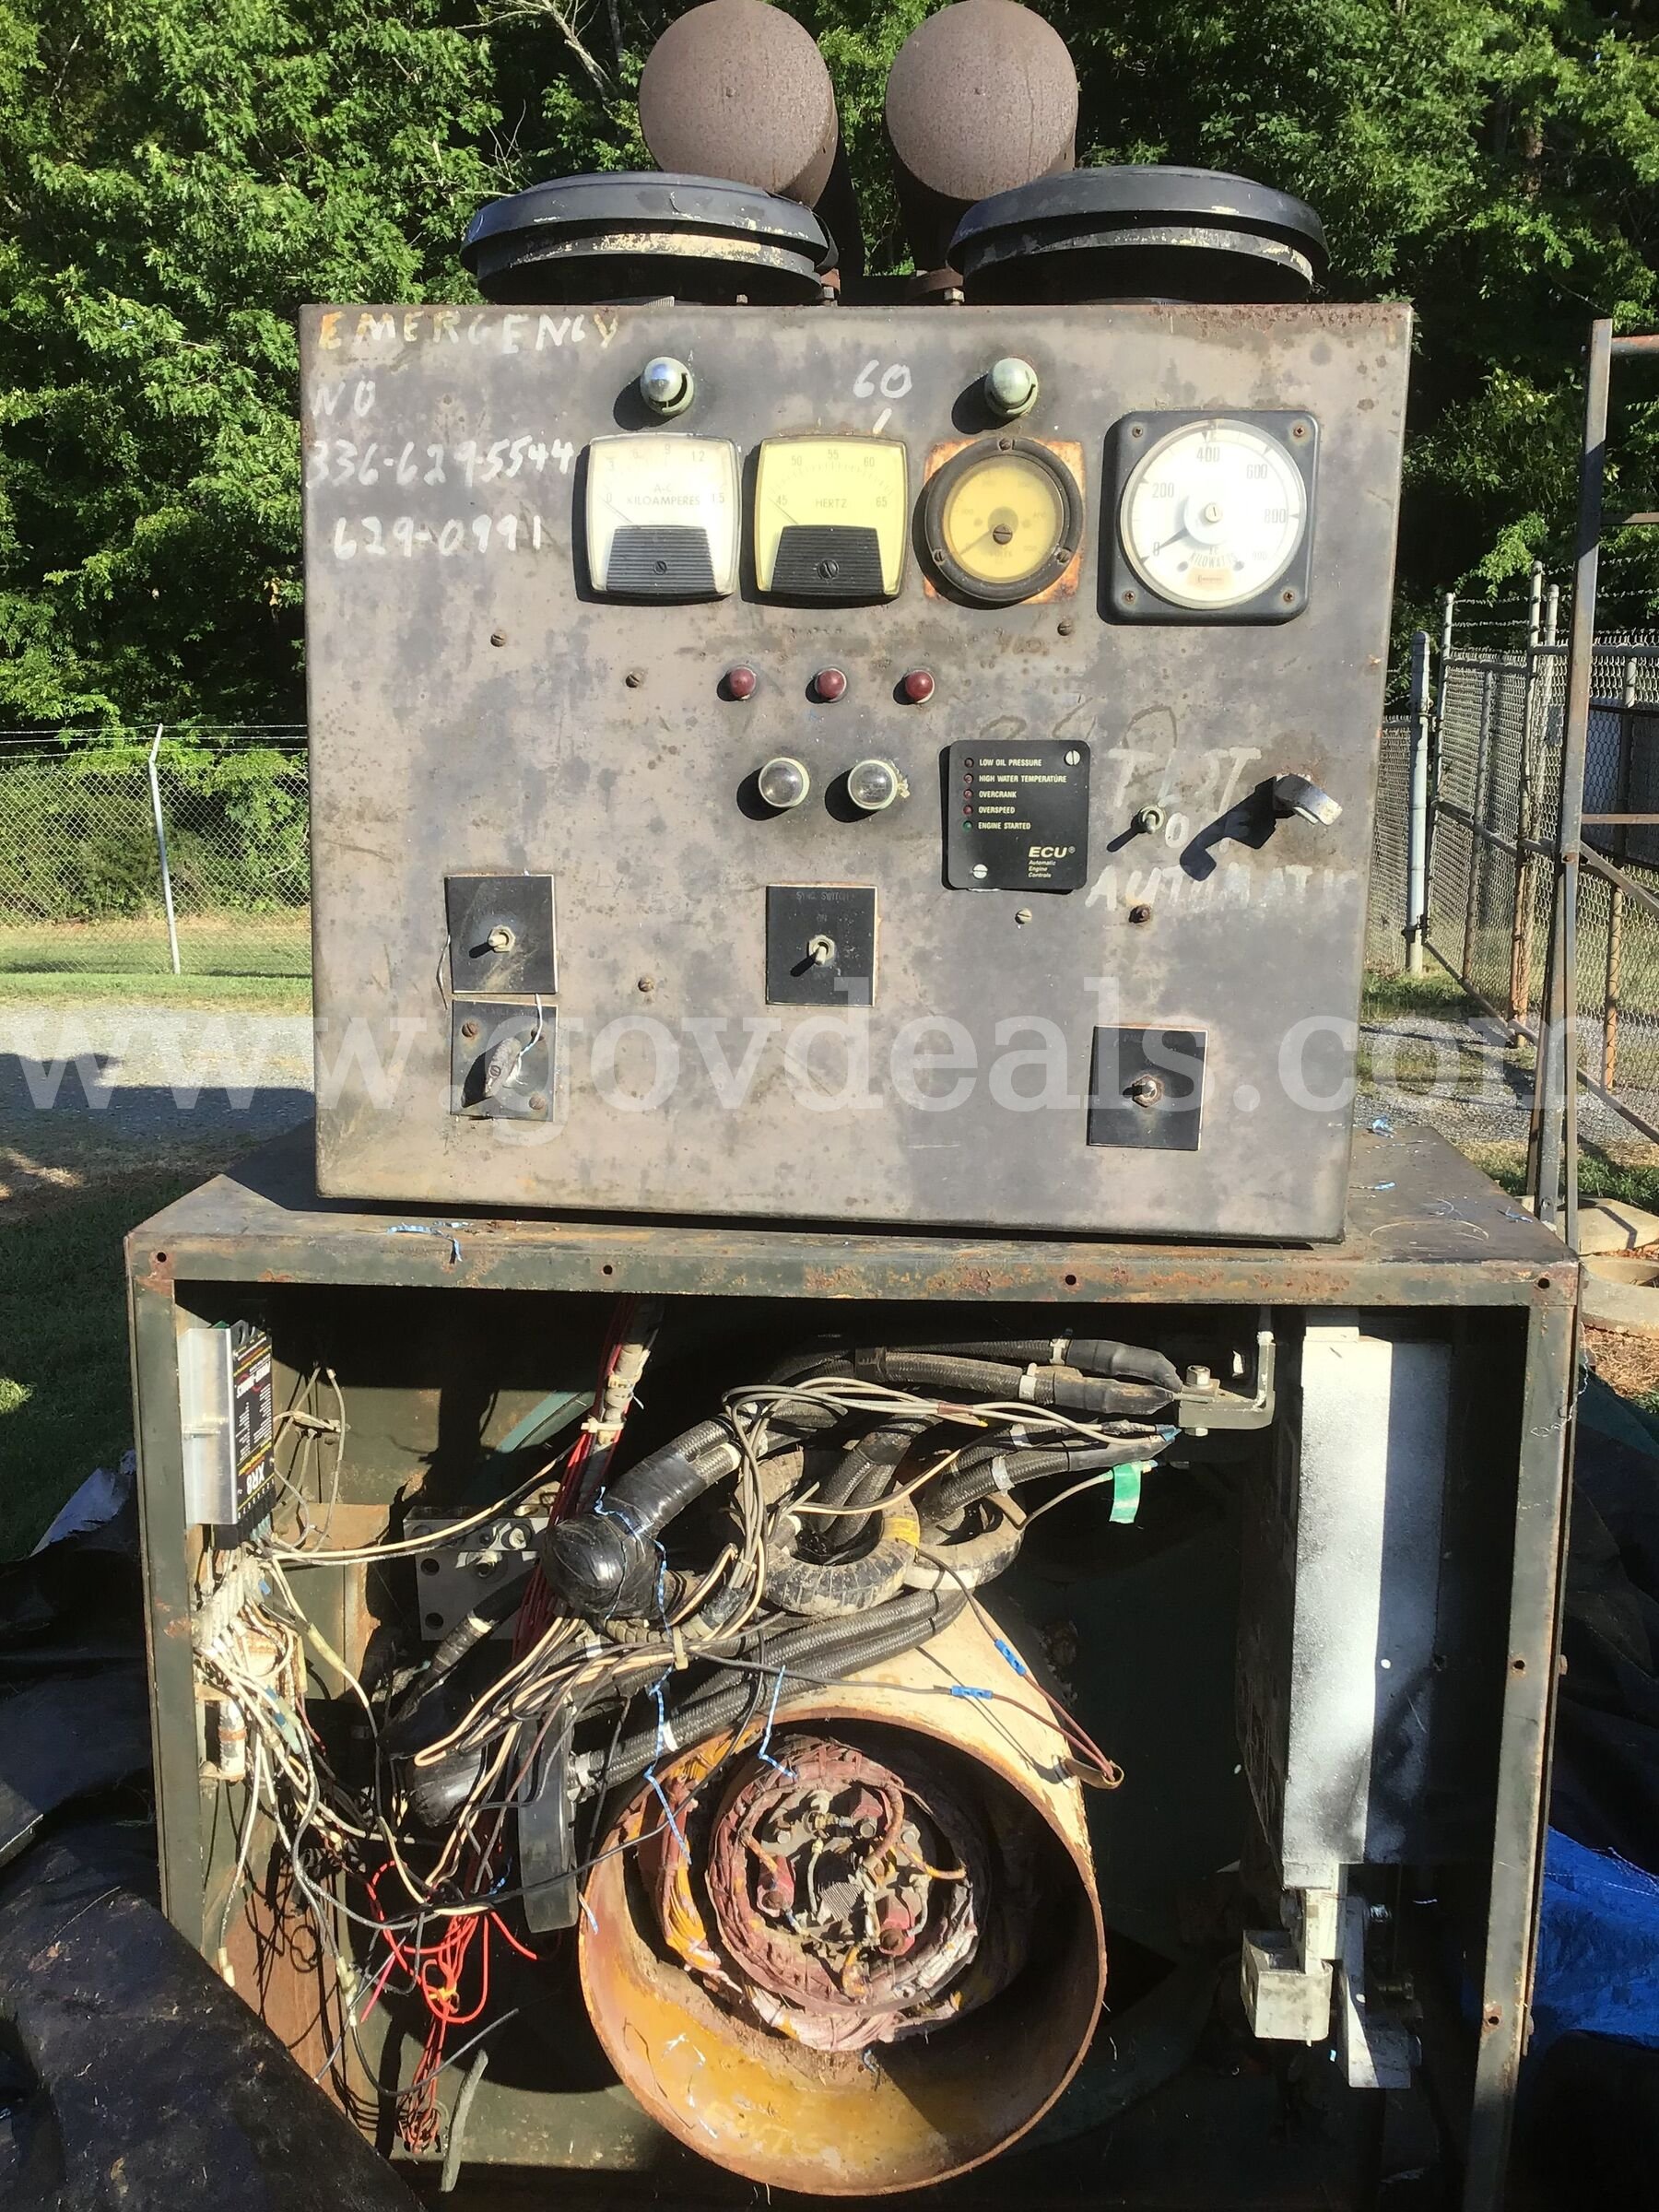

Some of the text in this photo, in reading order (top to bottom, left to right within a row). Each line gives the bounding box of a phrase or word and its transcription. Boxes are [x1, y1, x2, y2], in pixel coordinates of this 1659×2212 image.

[853, 359, 912, 399] 60
[828, 448, 839, 461] 55
[1196, 446, 1221, 463] 400
[791, 455, 803, 466] 50
[864, 456, 875, 467] 60
[1246, 464, 1268, 479] 600
[1152, 482, 1174, 499] 200
[627, 495, 701, 506] KILOAMPERES
[776, 494, 788, 506] 45
[815, 498, 848, 509] HERTZ
[876, 496, 888, 508] 65
[1264, 508, 1288, 524] 800
[333, 513, 542, 560] 629-0991
[979, 759, 1042, 767] LOW OIL PRESSURE
[1021, 774, 1067, 783] TEMPERATURE
[979, 791, 1018, 799] OVERCRANK
[978, 806, 1016, 815] OVERSPEED
[1004, 822, 1031, 830] STARTED
